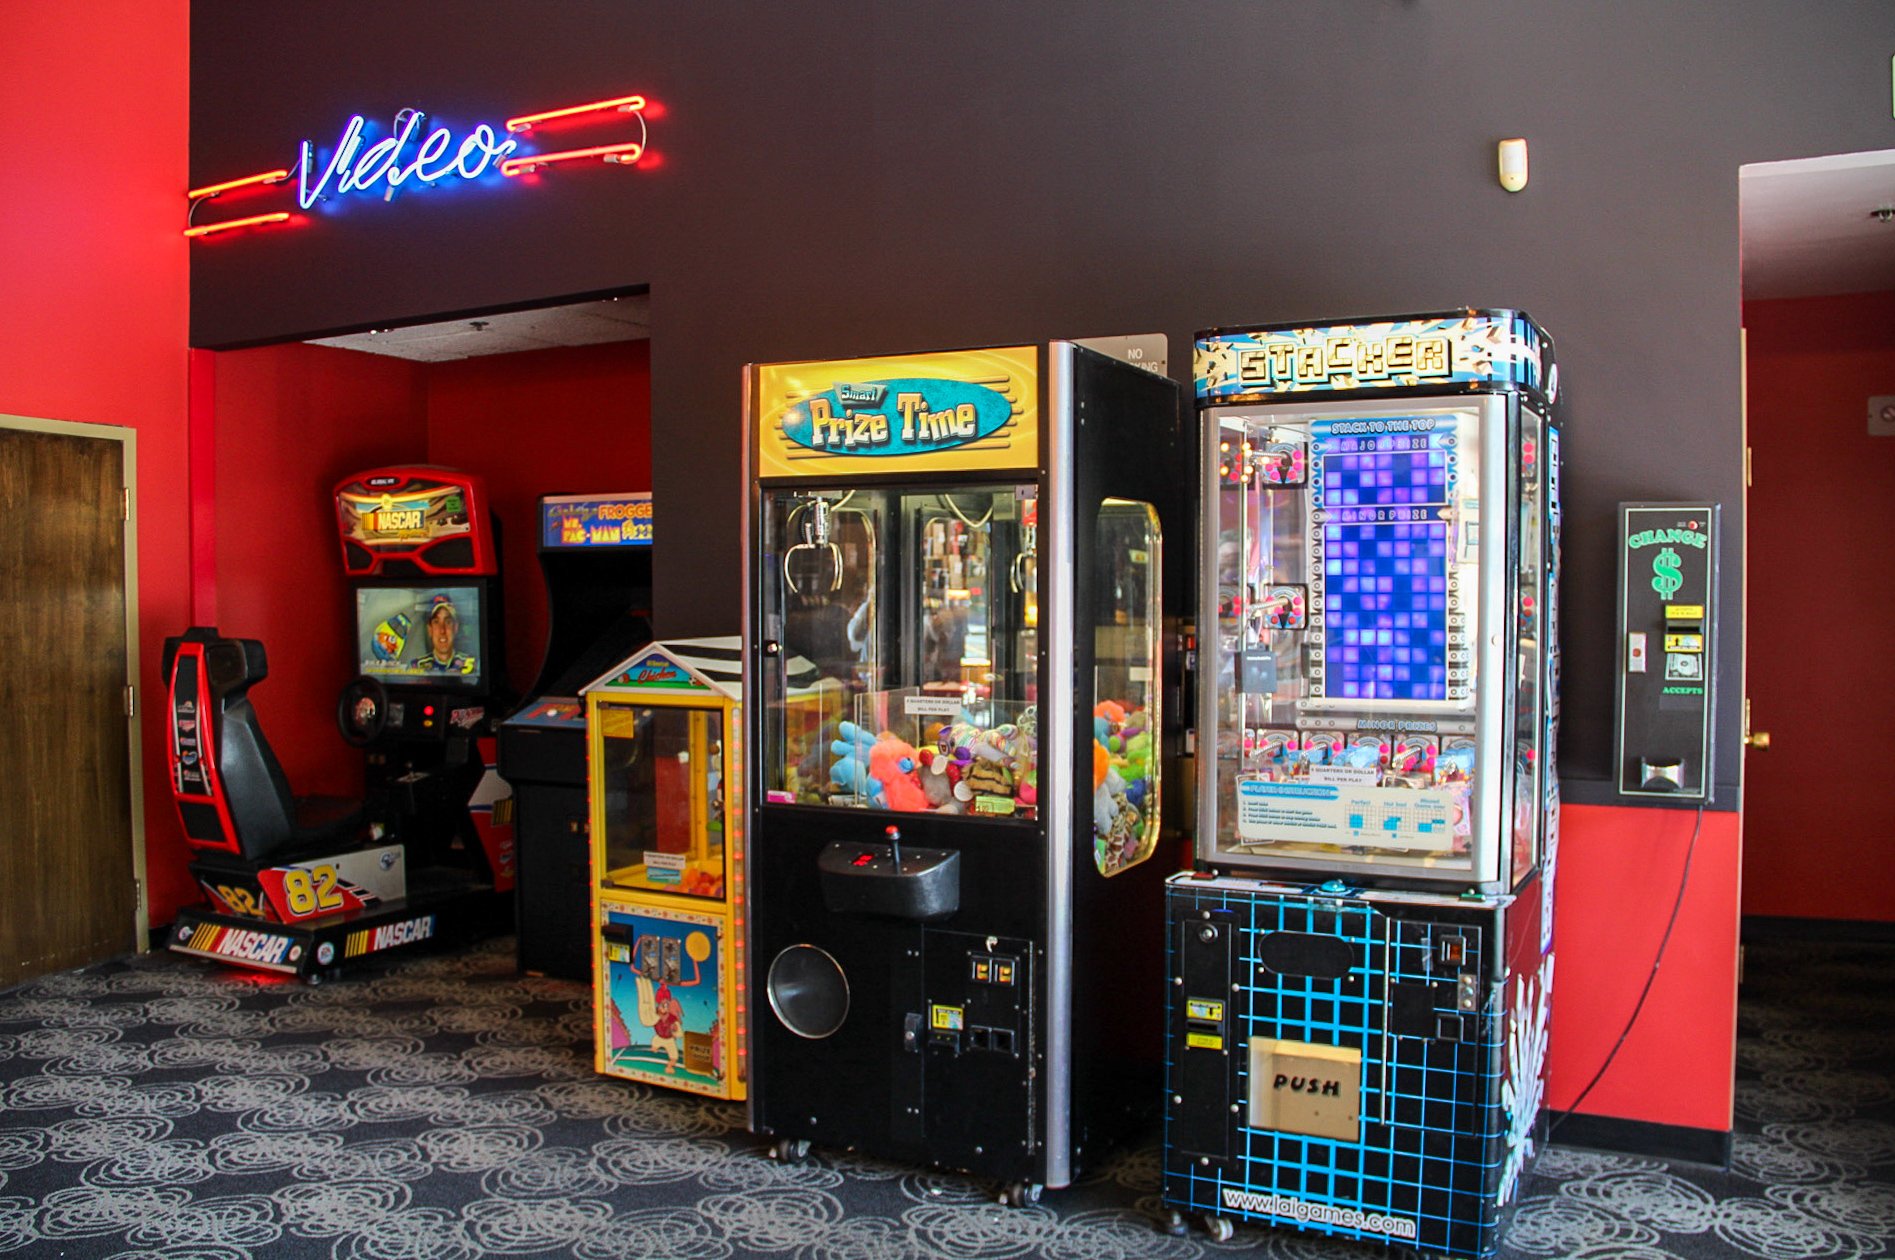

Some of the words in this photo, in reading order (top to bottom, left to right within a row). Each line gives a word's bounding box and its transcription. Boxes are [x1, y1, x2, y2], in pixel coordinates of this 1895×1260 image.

[298, 110, 517, 209] Video
[1127, 348, 1143, 360] NO
[1238, 335, 1447, 381] STACKER
[841, 385, 878, 401] Smart
[809, 398, 889, 447] Prize
[897, 392, 977, 441] Time
[1331, 421, 1367, 435] STACK
[1368, 421, 1386, 433] TO
[1386, 419, 1410, 432] THE
[1411, 417, 1436, 431] TOP
[377, 511, 421, 530] NASCAR
[598, 502, 652, 520] FROGGE
[1341, 509, 1386, 522] MINOR
[1388, 508, 1428, 521] PRIZE
[562, 526, 621, 544] PAC-MAN
[1628, 528, 1708, 549] CHANGE
[1651, 547, 1684, 600] $
[461, 657, 476, 675] 5
[1662, 686, 1704, 696] ACCEPTS
[1356, 719, 1396, 731] MINOR
[1397, 720, 1437, 733] PRIZES
[216, 884, 267, 918] 82
[283, 863, 344, 918] 82
[373, 915, 433, 952] NASCAR
[215, 928, 290, 965] NASCAR
[1272, 1073, 1341, 1097] PUSH
[1222, 1187, 1417, 1239] www.laigames.com
